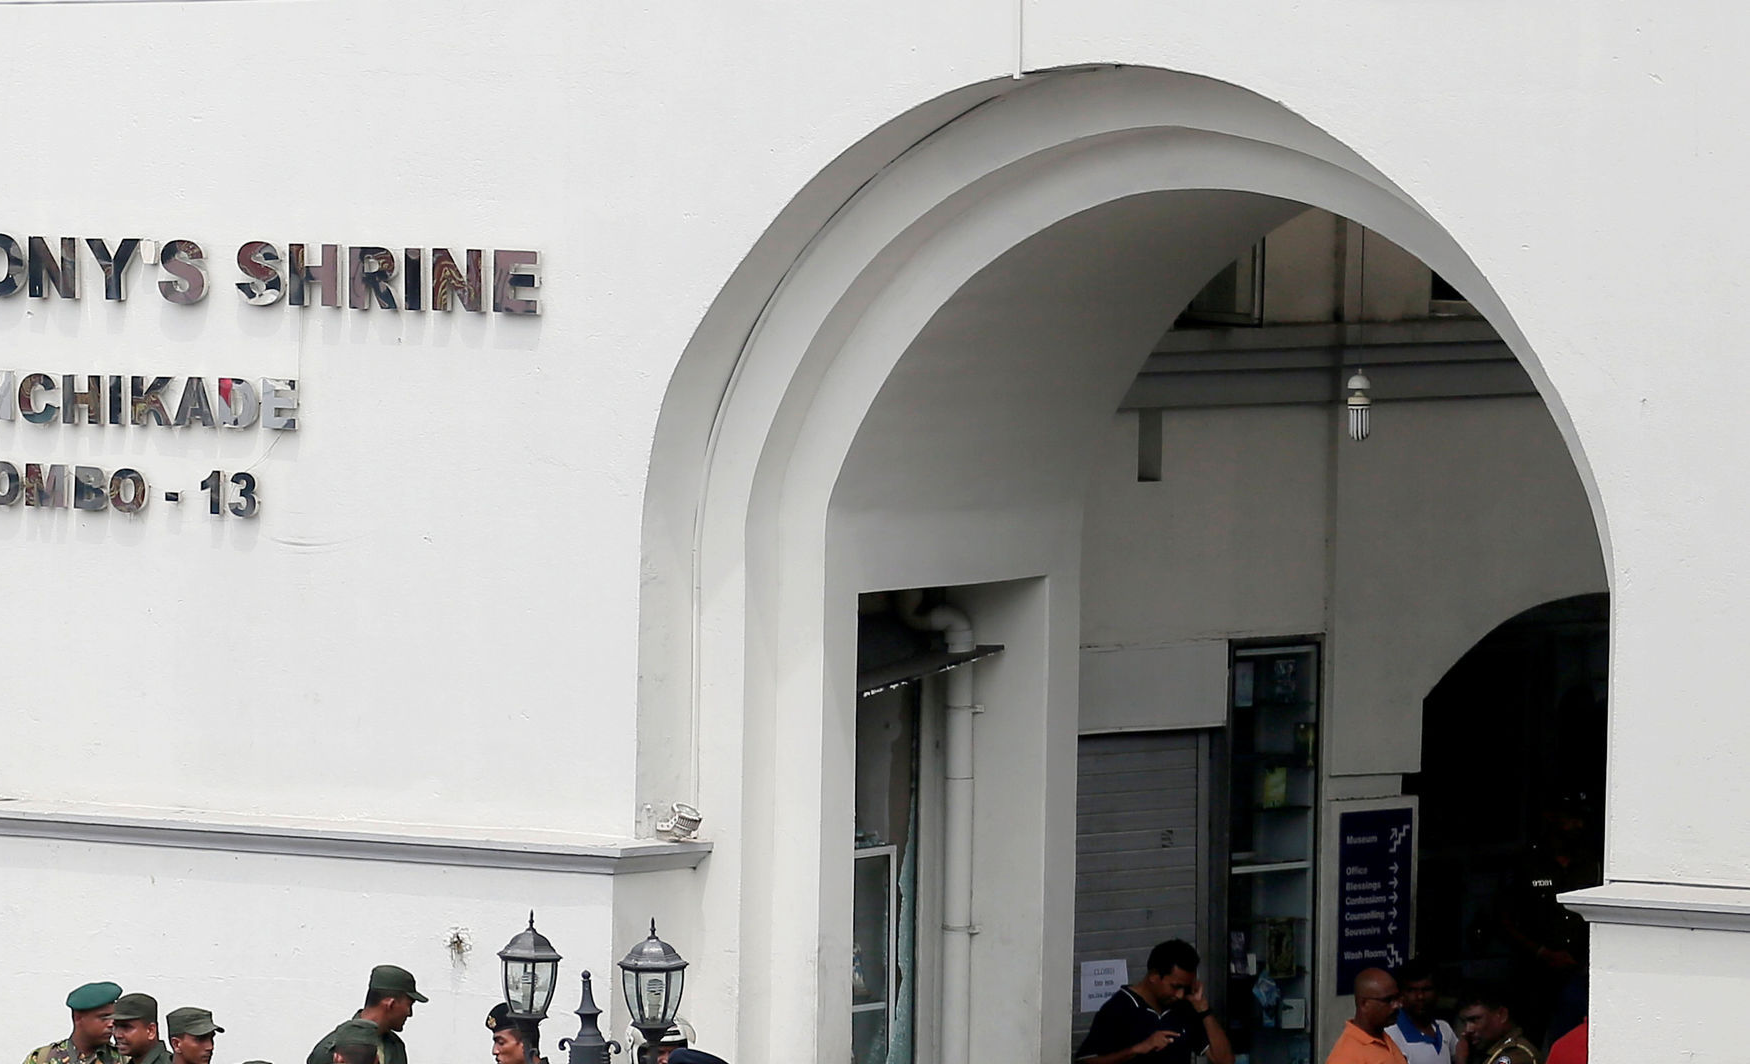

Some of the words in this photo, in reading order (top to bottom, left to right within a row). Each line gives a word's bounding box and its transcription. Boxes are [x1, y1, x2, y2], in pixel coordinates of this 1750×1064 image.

[235, 240, 543, 315] SHRINE
[199, 469, 260, 518] 13
[1346, 835, 1378, 845] Museum
[1346, 866, 1368, 876] Office
